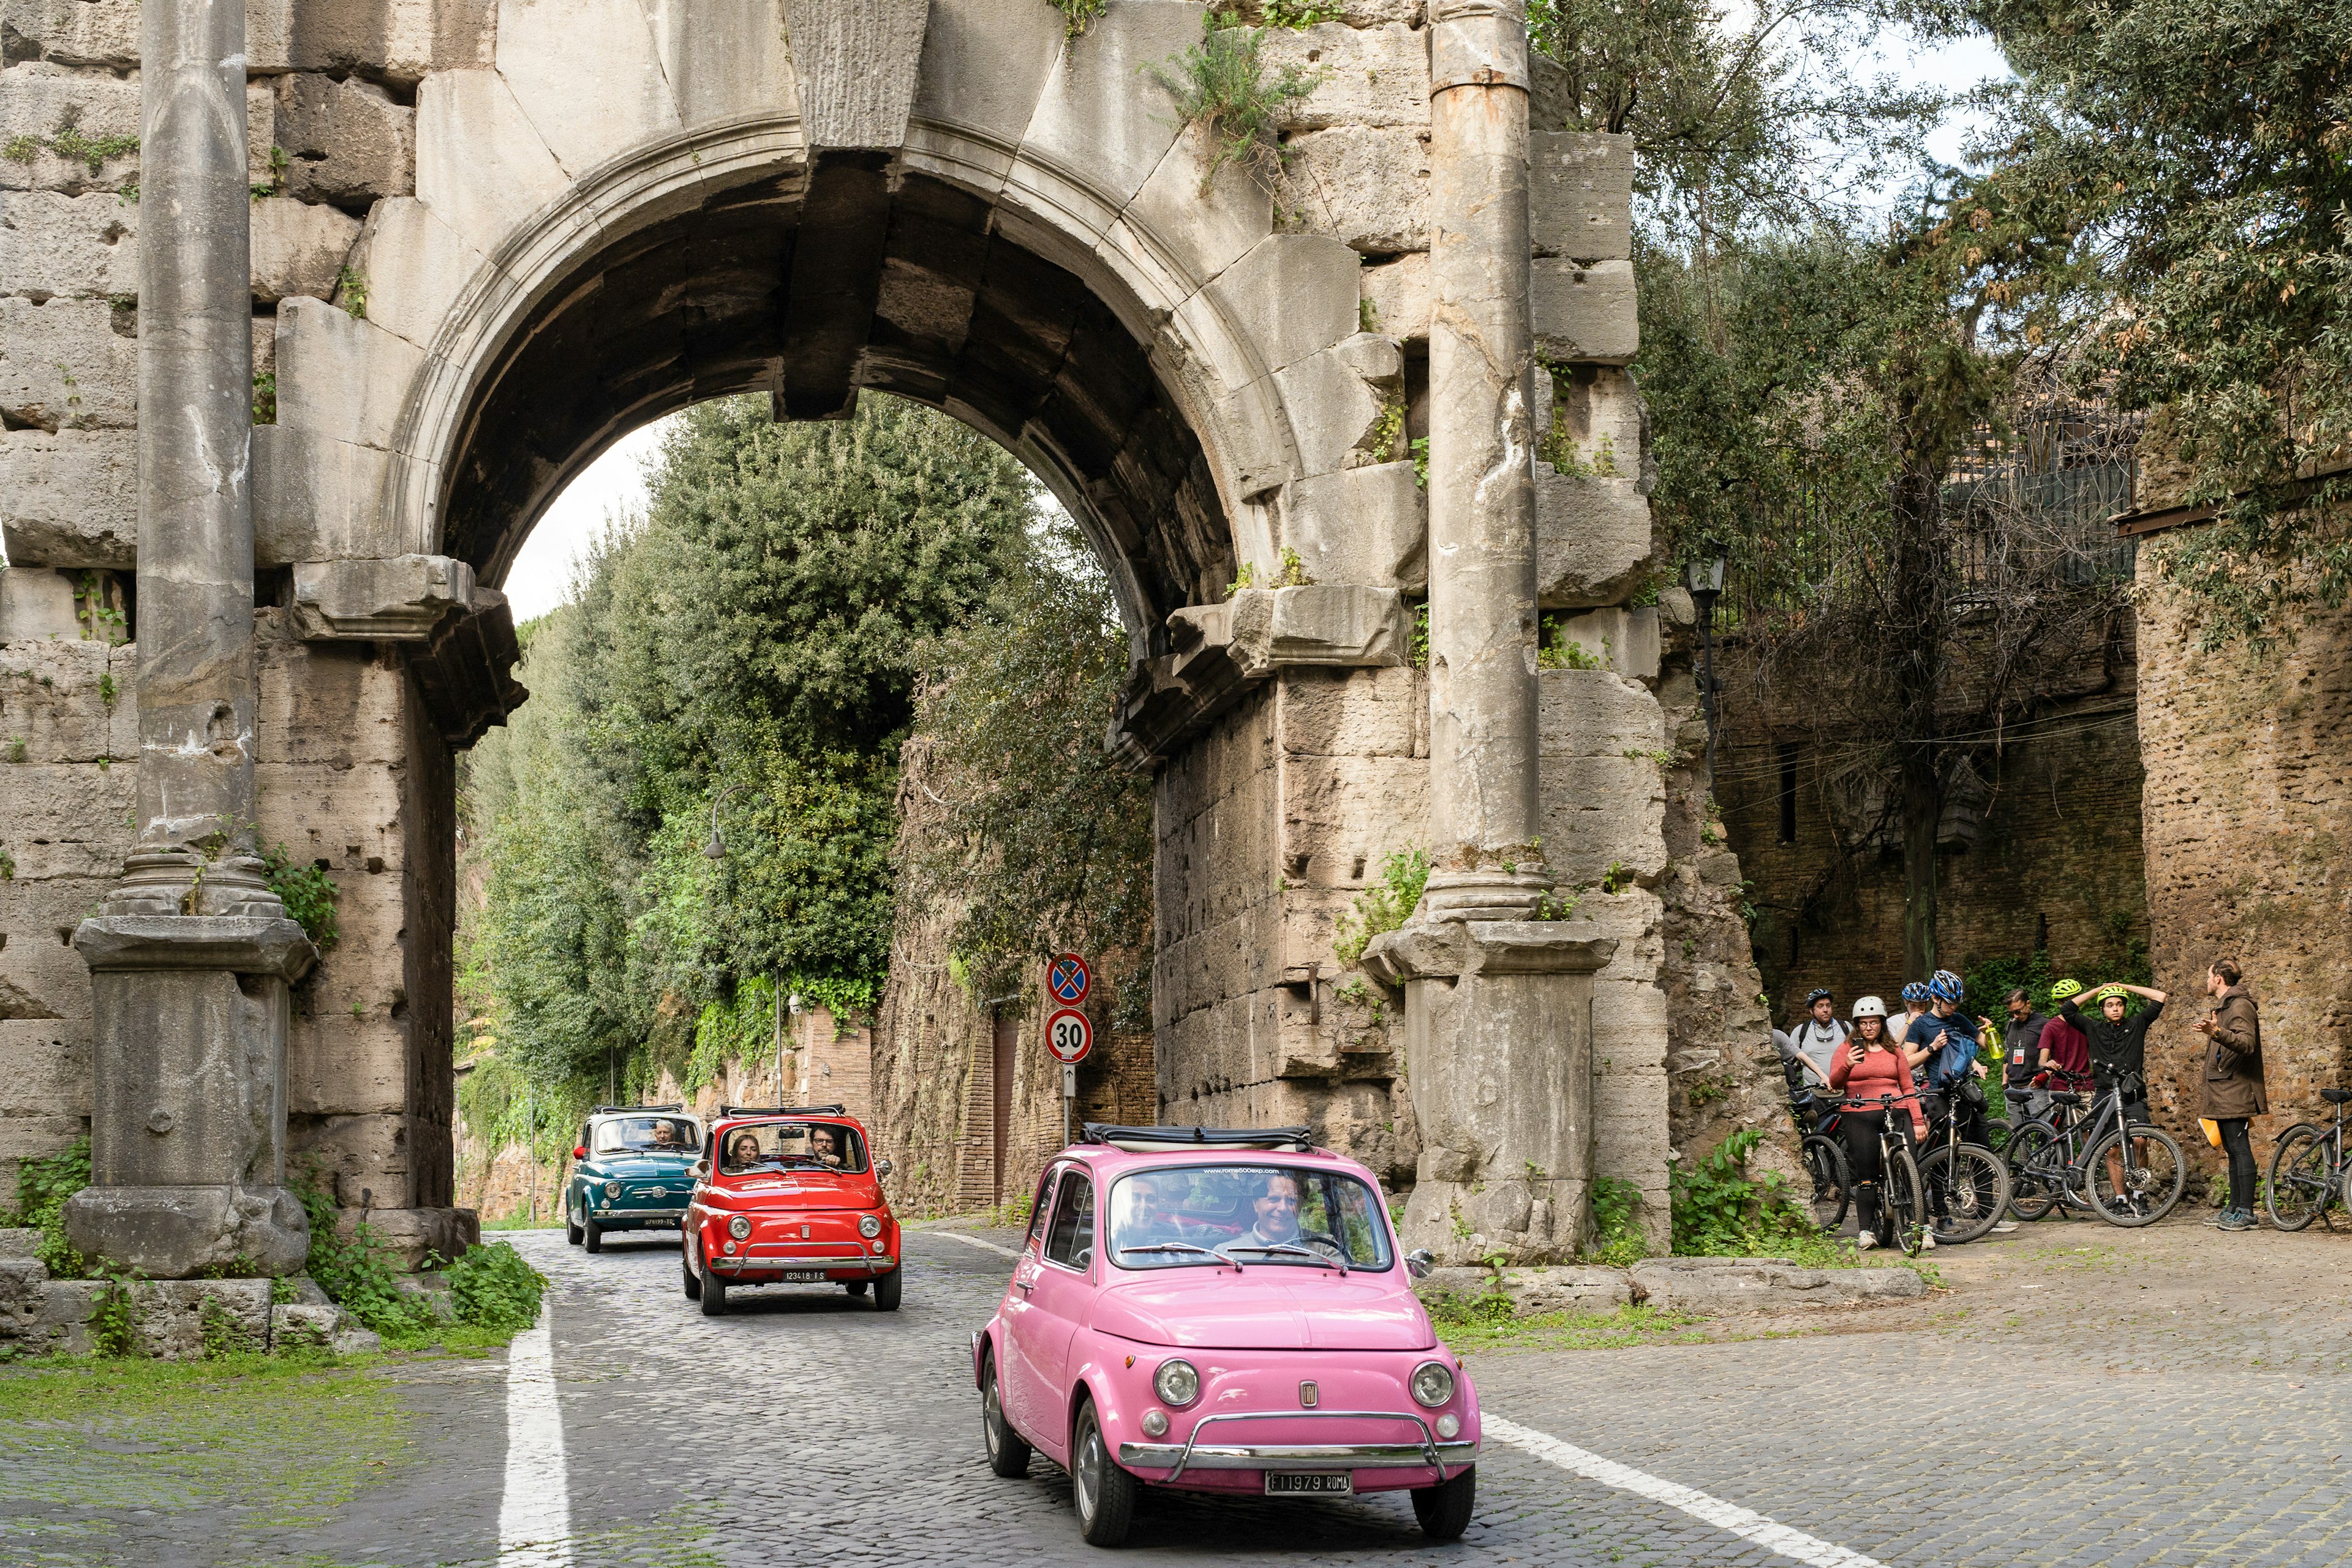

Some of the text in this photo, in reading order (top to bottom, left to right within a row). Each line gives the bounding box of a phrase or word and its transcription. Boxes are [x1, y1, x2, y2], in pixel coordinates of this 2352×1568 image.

[1056, 1023, 1082, 1048] 30
[1303, 1385, 1314, 1403] FIAT
[1327, 1476, 1348, 1490] ROMA
